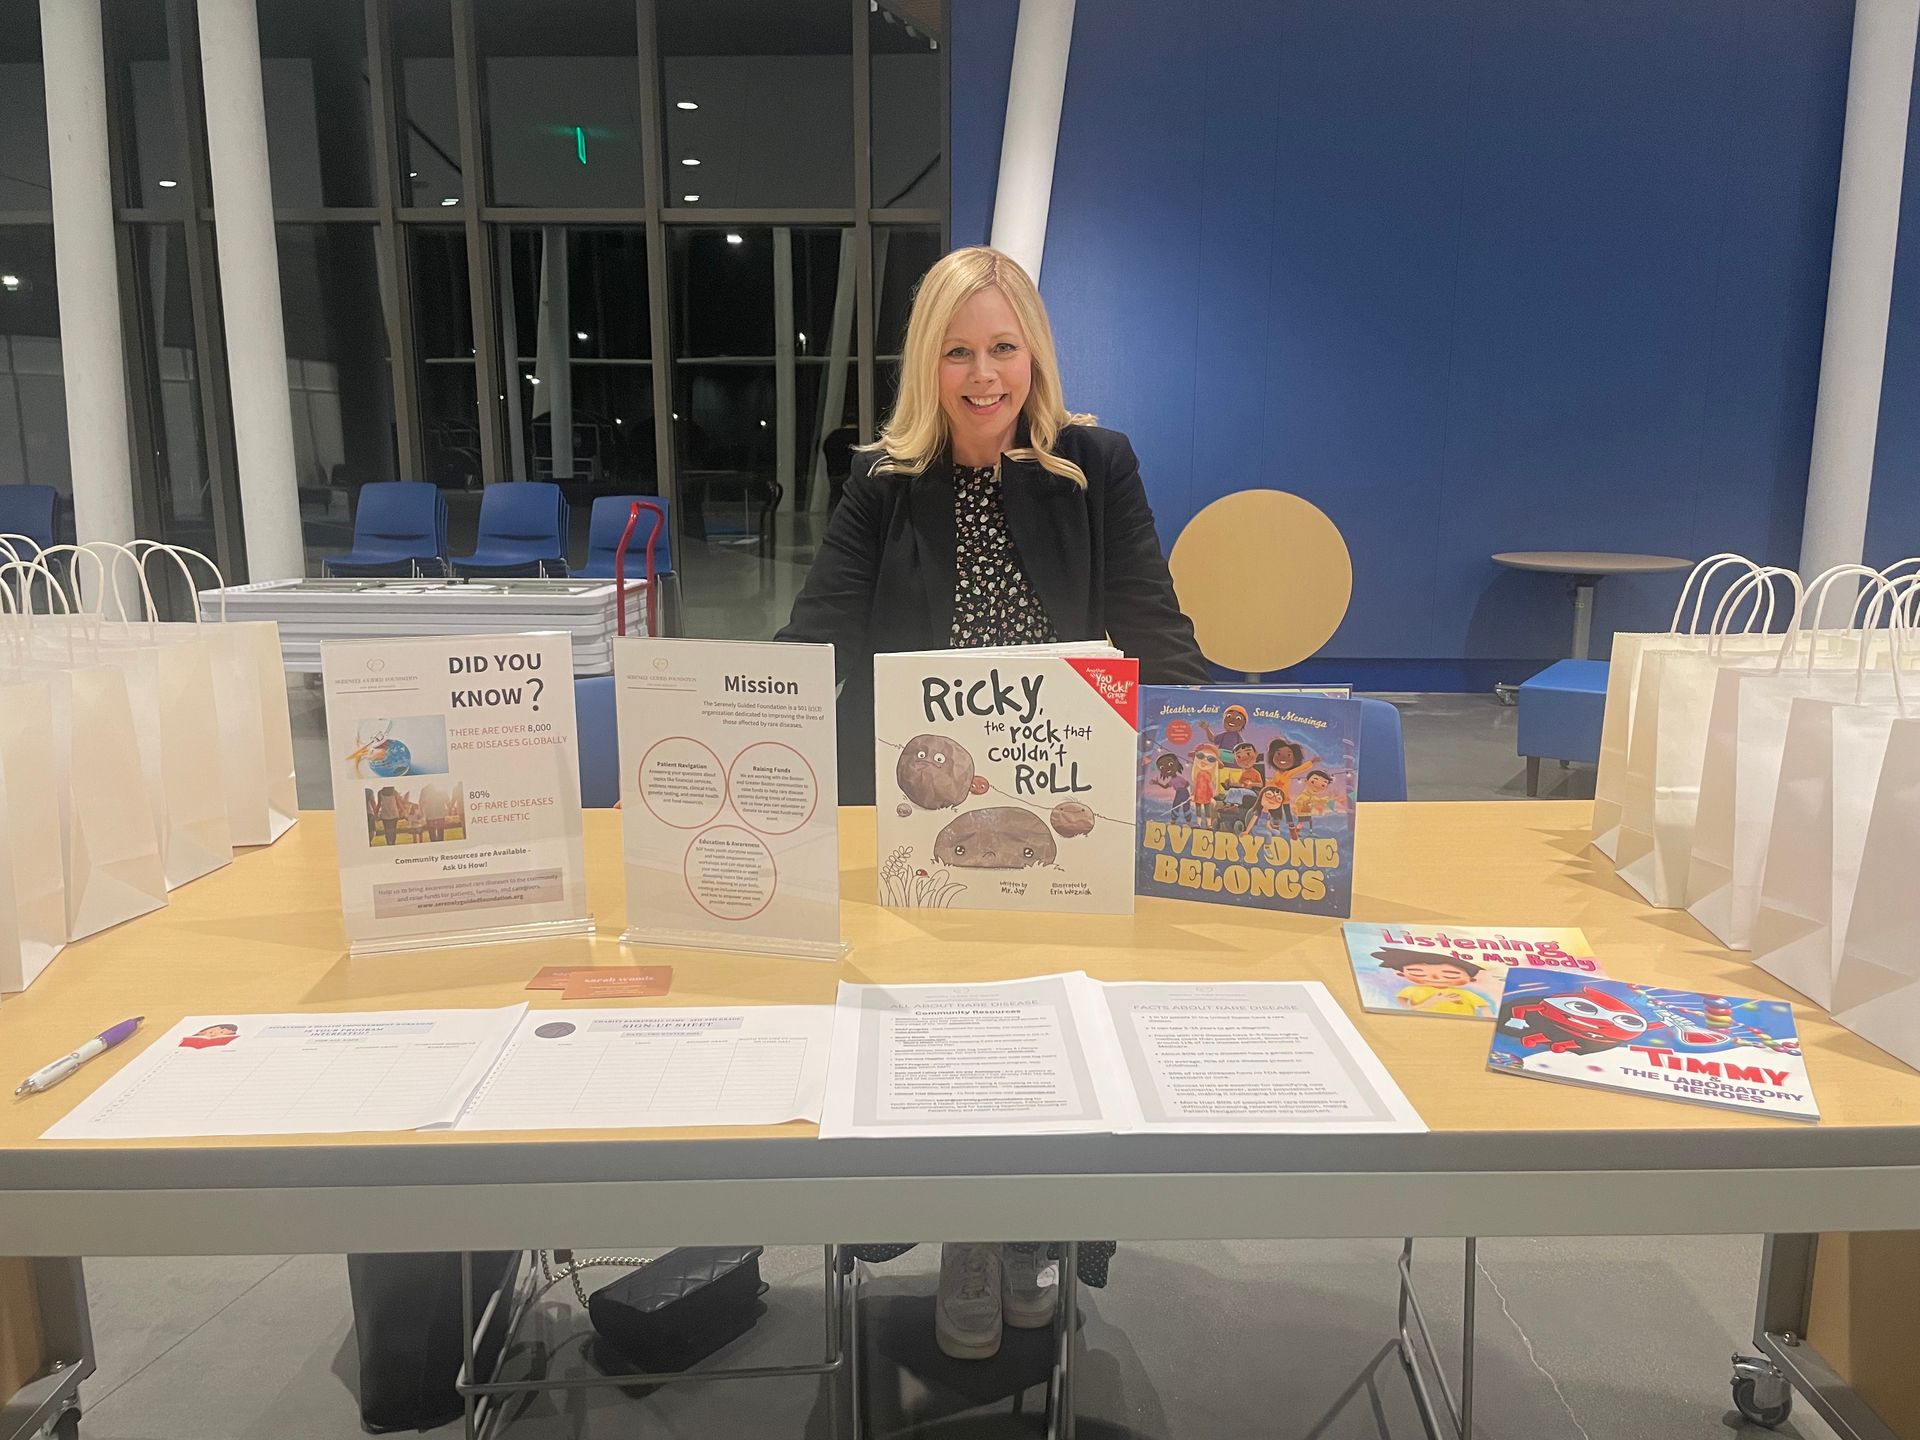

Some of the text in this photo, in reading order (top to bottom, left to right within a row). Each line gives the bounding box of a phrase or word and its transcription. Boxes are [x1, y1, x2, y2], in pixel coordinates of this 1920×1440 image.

[449, 653, 541, 674] DID YOU
[724, 675, 798, 695] Mission
[922, 668, 1044, 724] Ricky,
[1160, 704, 1220, 716] Heather Avis
[1253, 707, 1328, 729] Sarah Mensinga
[450, 728, 480, 736] THERE
[502, 726, 526, 734] OVER
[527, 723, 551, 733] 8,000
[984, 720, 1092, 745] the rock that
[450, 736, 568, 750] RARE DISEASES GLOBALLY
[988, 742, 1066, 767] couldn't
[469, 790, 490, 799] 80%
[470, 797, 554, 810] OF RARE DISEASES
[471, 813, 530, 824] ARE GENETIC
[1143, 820, 1340, 869] EVERYONE
[395, 856, 438, 865] Community
[440, 853, 478, 861] Resources
[493, 848, 526, 856] Available
[1153, 854, 1327, 901] BELONGS
[1380, 928, 1567, 958] Listening
[1450, 950, 1596, 972] to My Body
[1620, 1066, 1804, 1102] THE LABORATORY
[1674, 1083, 1765, 1104] HEROES
